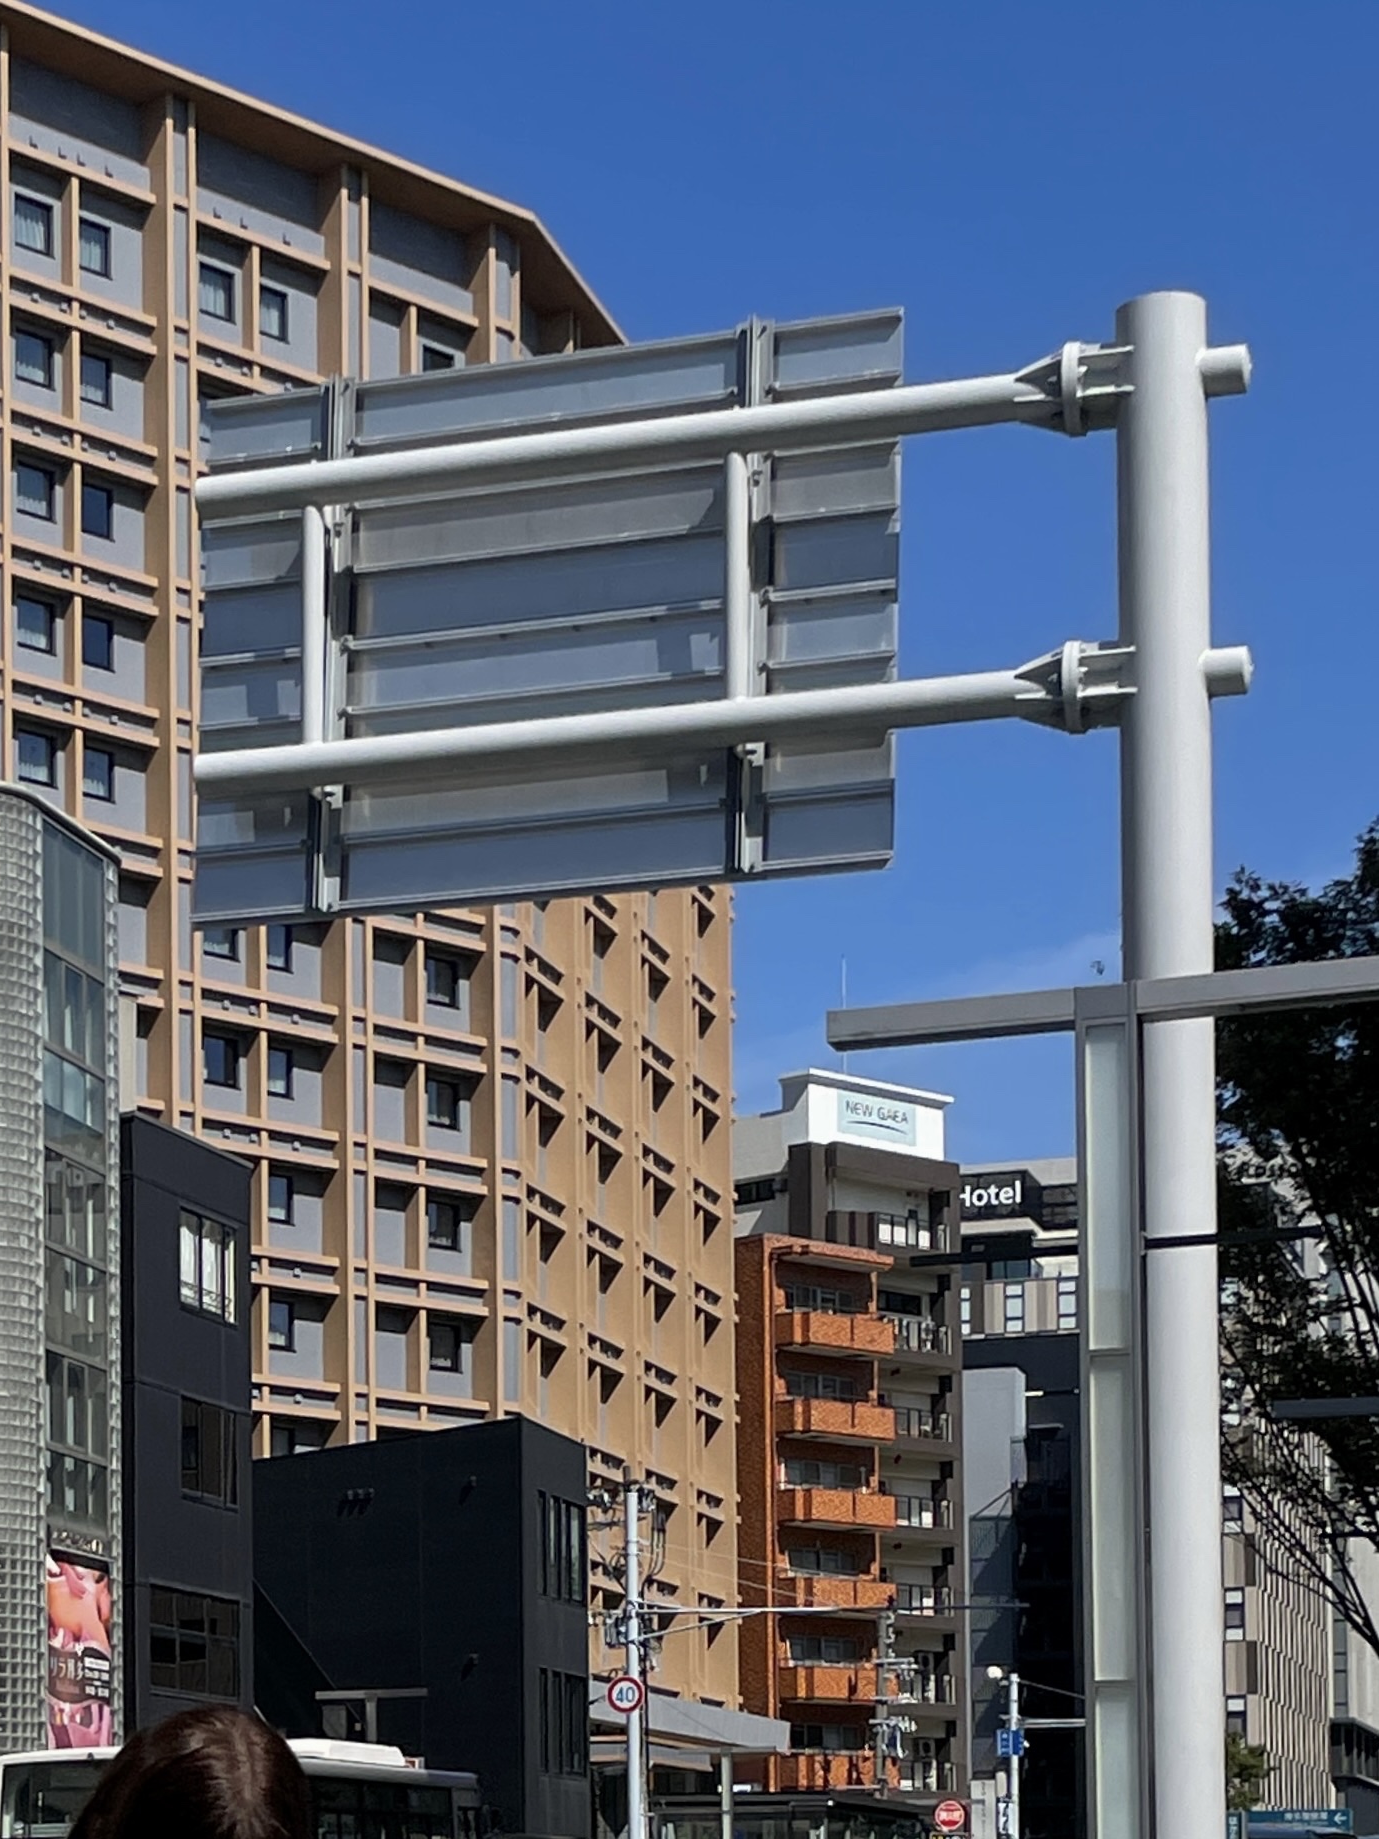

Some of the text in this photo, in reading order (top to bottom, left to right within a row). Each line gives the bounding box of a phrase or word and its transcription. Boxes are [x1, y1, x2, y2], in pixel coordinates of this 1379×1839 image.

[846, 1100, 873, 1118] NEW
[959, 1180, 1022, 1208] Hotel
[615, 1686, 636, 1703] 40
